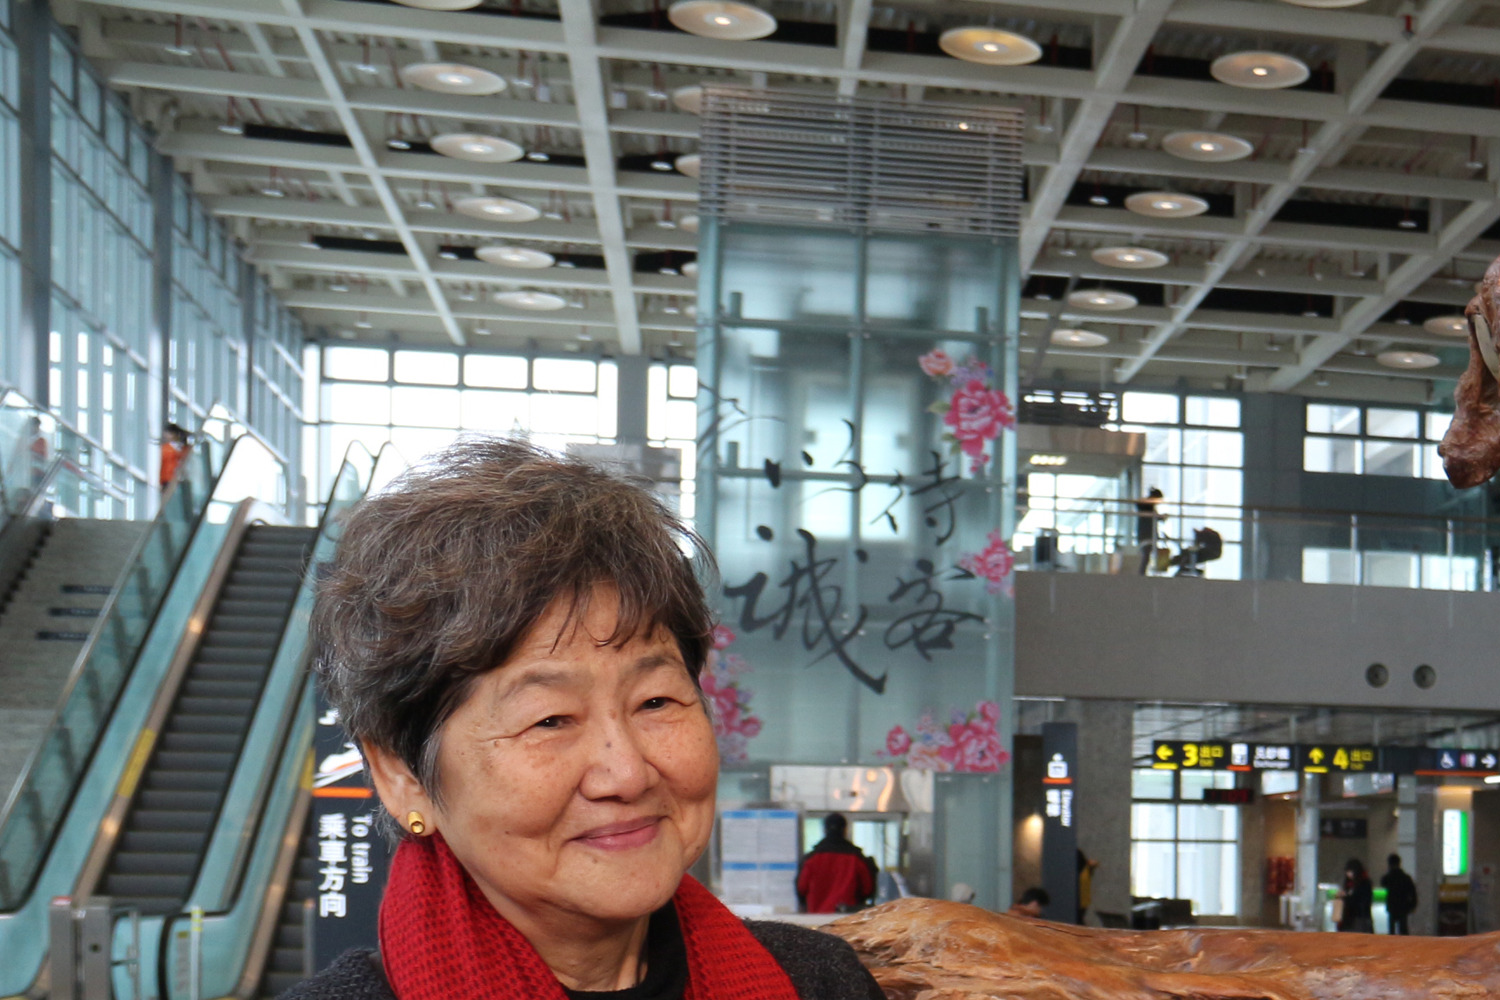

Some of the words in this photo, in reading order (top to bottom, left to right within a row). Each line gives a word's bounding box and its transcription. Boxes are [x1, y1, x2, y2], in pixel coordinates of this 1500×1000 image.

[1182, 743, 1199, 767] 3
[1333, 747, 1349, 769] 4
[351, 813, 373, 837] To
[318, 812, 348, 918] 乘車方向
[351, 842, 373, 884] train
